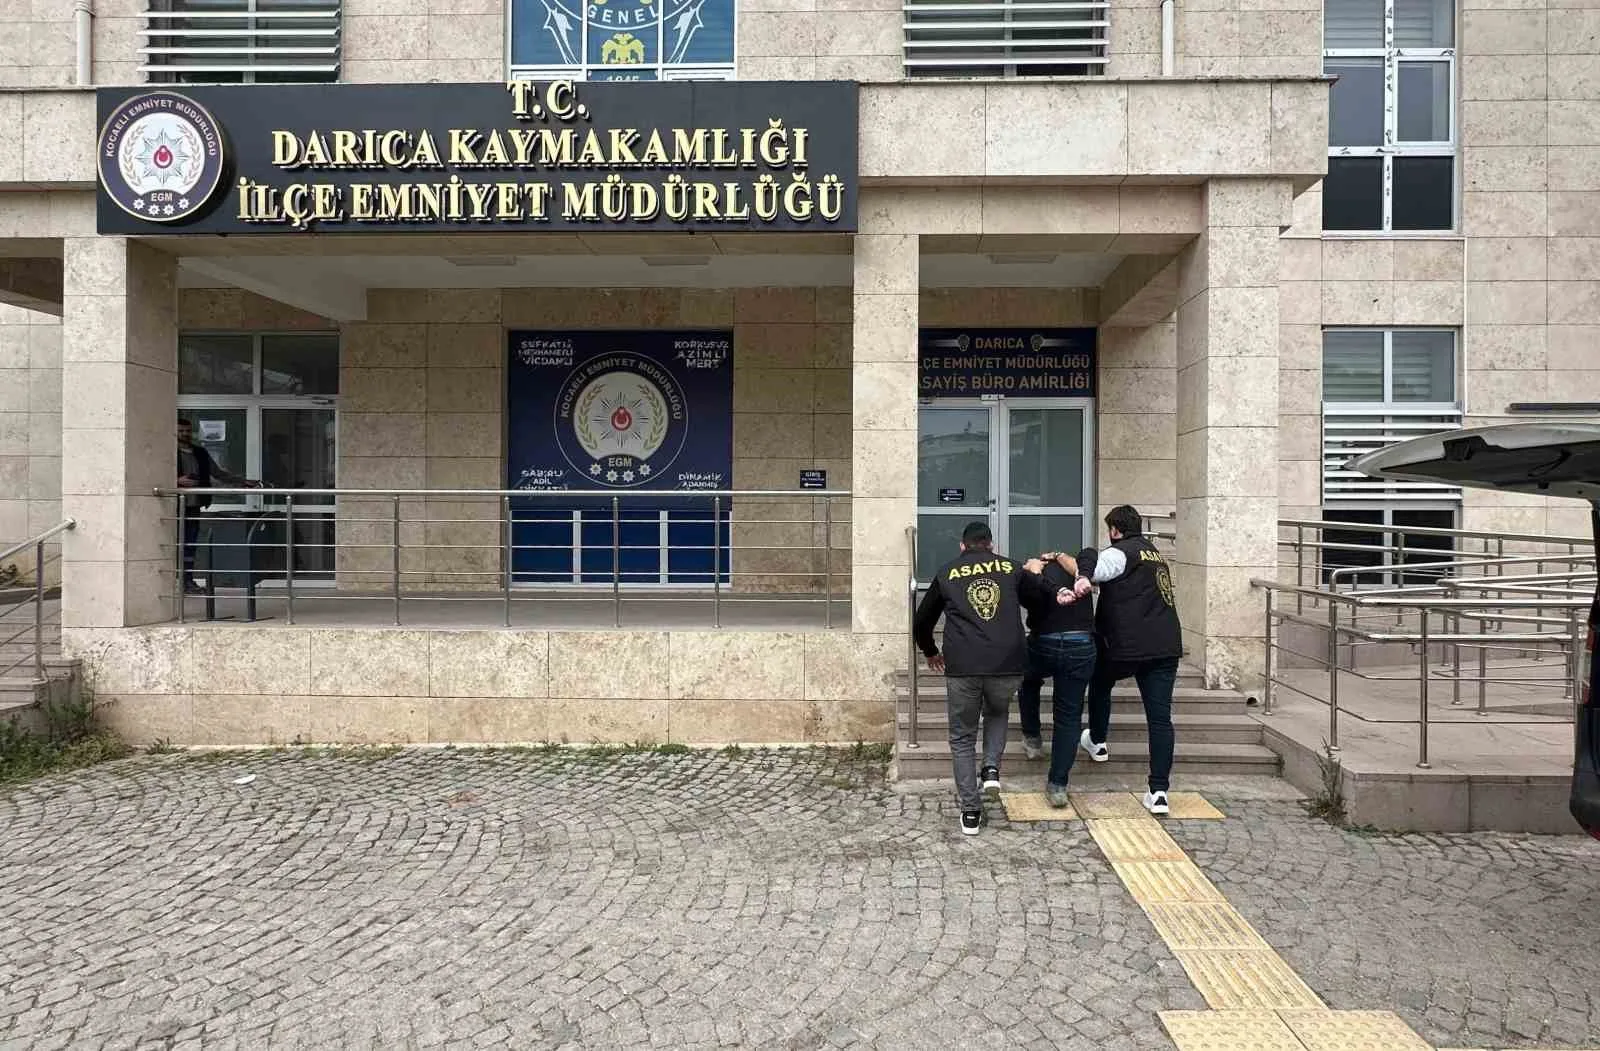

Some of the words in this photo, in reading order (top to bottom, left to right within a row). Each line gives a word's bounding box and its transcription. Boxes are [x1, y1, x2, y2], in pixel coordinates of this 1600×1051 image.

[507, 80, 588, 118] T.C.
[105, 114, 130, 157] KOCAELİ
[128, 98, 174, 117] EMNİYET
[175, 102, 217, 156] MÜDÜRLÜĞÜ
[271, 129, 442, 166] DARICA
[448, 117, 810, 167] KAYMAKAMLIĞI
[151, 192, 173, 203] EGM
[235, 176, 342, 231] İLÇE
[350, 174, 553, 221] EMNİYET
[561, 172, 845, 221] MÜDÜRLÜĞÜ
[975, 337, 1025, 349] DARICA
[943, 354, 1001, 369] EMNİYET
[1005, 355, 1090, 369] MÜDÜRLÜĞÜ
[971, 373, 1014, 389] BÜRO
[1018, 372, 1090, 389] AMİRLİĞİ
[608, 457, 632, 467] EGM
[949, 559, 1013, 580] ASAYİŞ
